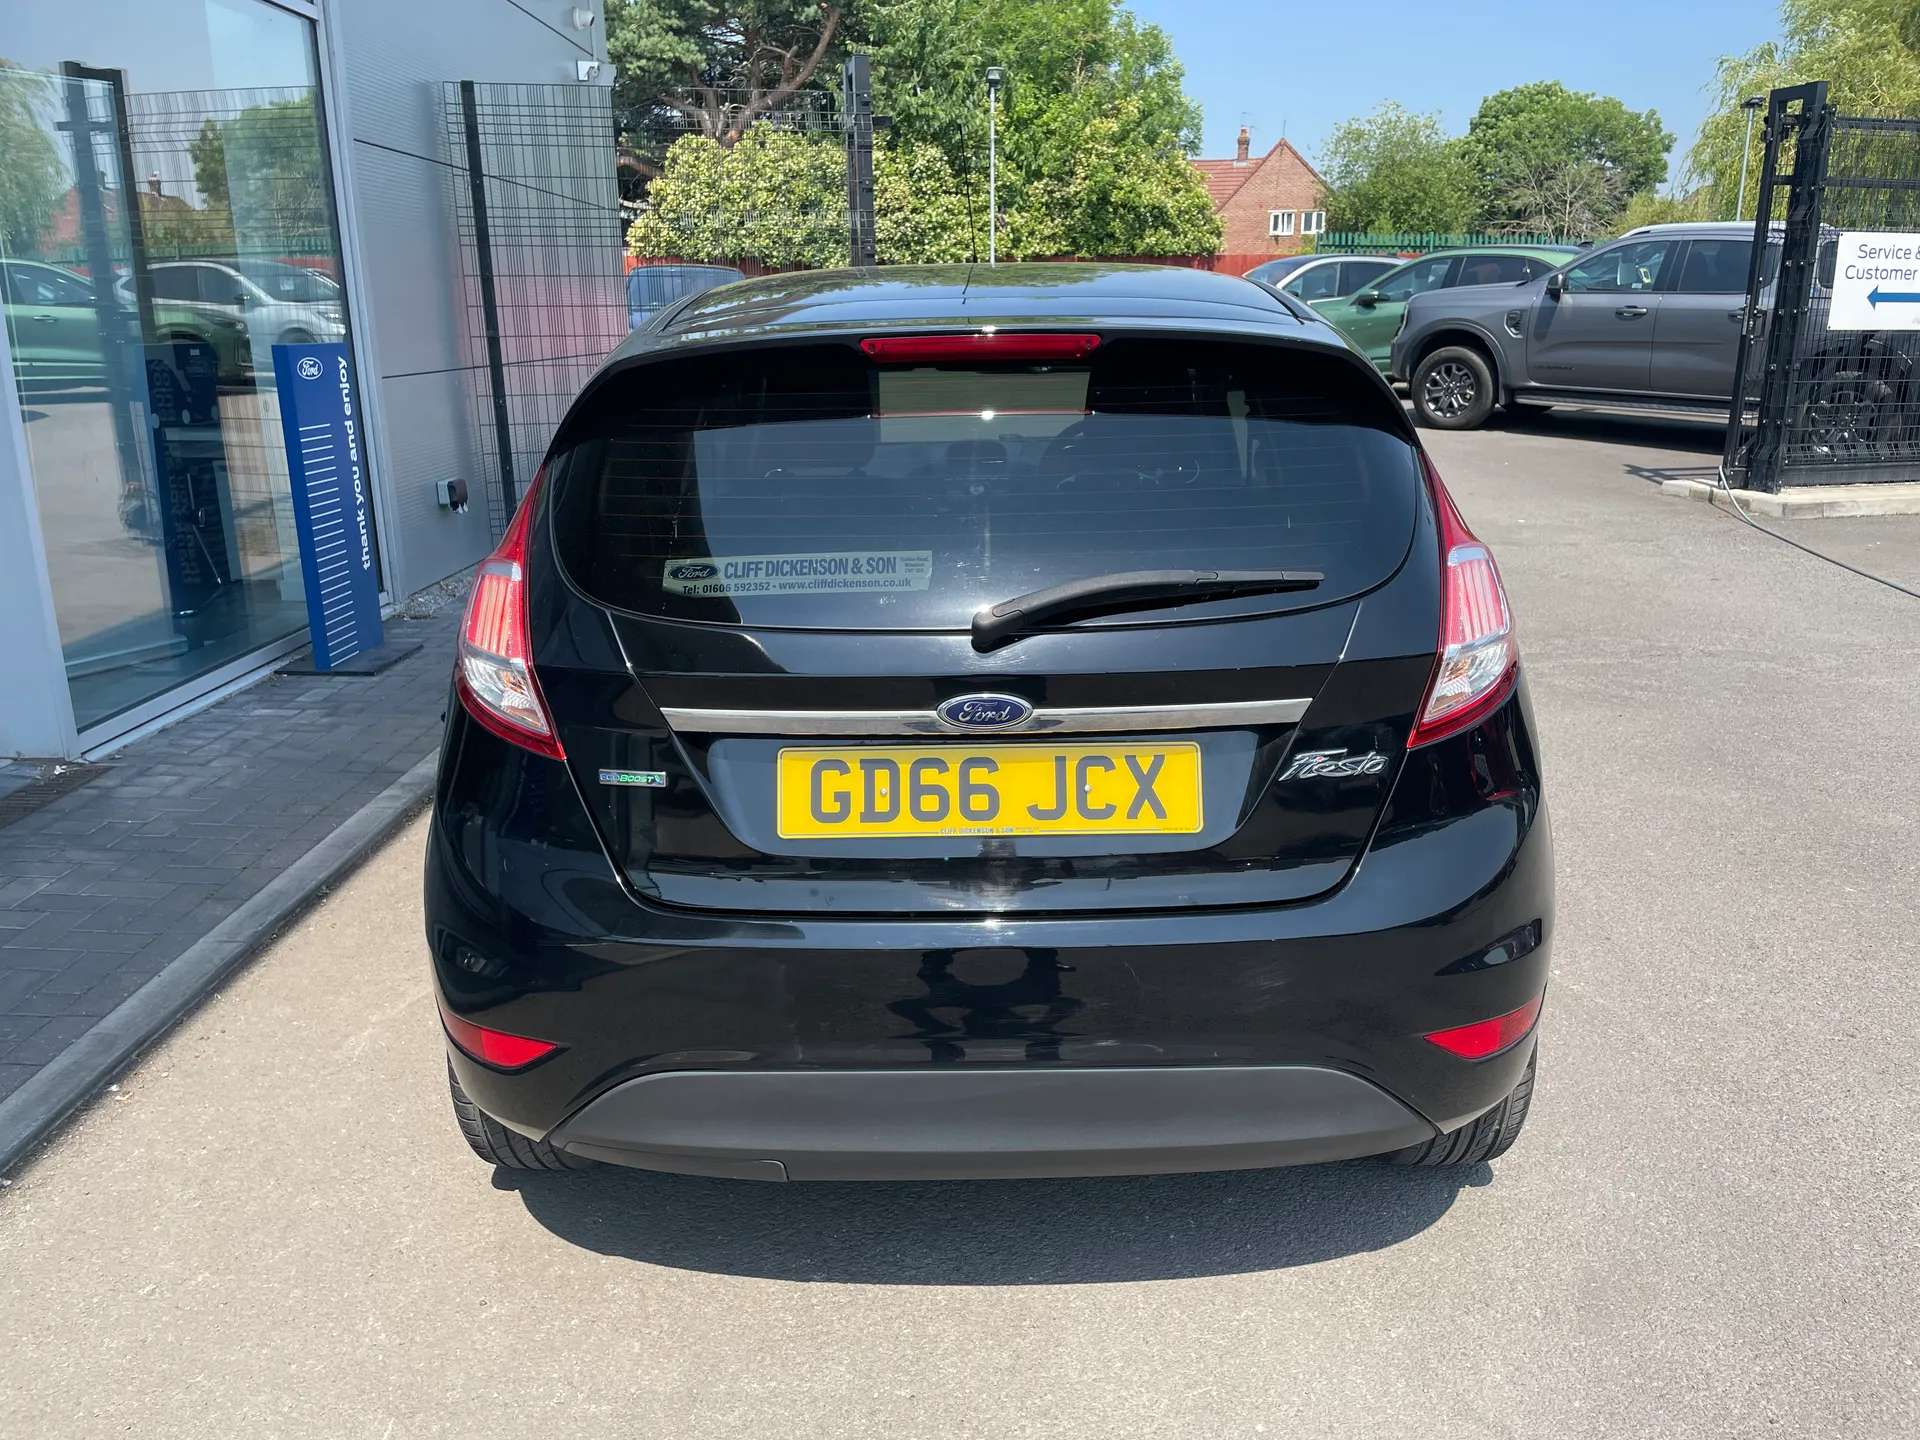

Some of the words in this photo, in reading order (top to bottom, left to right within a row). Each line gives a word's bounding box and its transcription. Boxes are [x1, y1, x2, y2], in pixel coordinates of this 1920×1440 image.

[1857, 243, 1912, 260] Service
[1845, 264, 1918, 281] Customer
[337, 355, 352, 417] enjoy
[344, 420, 358, 463] and
[352, 466, 365, 506] you
[356, 507, 371, 571] thank
[677, 565, 711, 578] Ford
[723, 560, 764, 579] CLIFF
[764, 558, 849, 578] DICKENSON
[850, 558, 864, 575] &
[865, 556, 897, 575] SON
[682, 585, 700, 595] Tel:
[702, 583, 732, 594] 01606
[733, 582, 771, 592] 592352
[778, 577, 912, 590] www.cliffdickenson.co.uk
[958, 701, 1011, 721] Ford
[1278, 748, 1388, 781] Fiesta
[810, 756, 1000, 823] GD66
[1026, 754, 1168, 821] JCX
